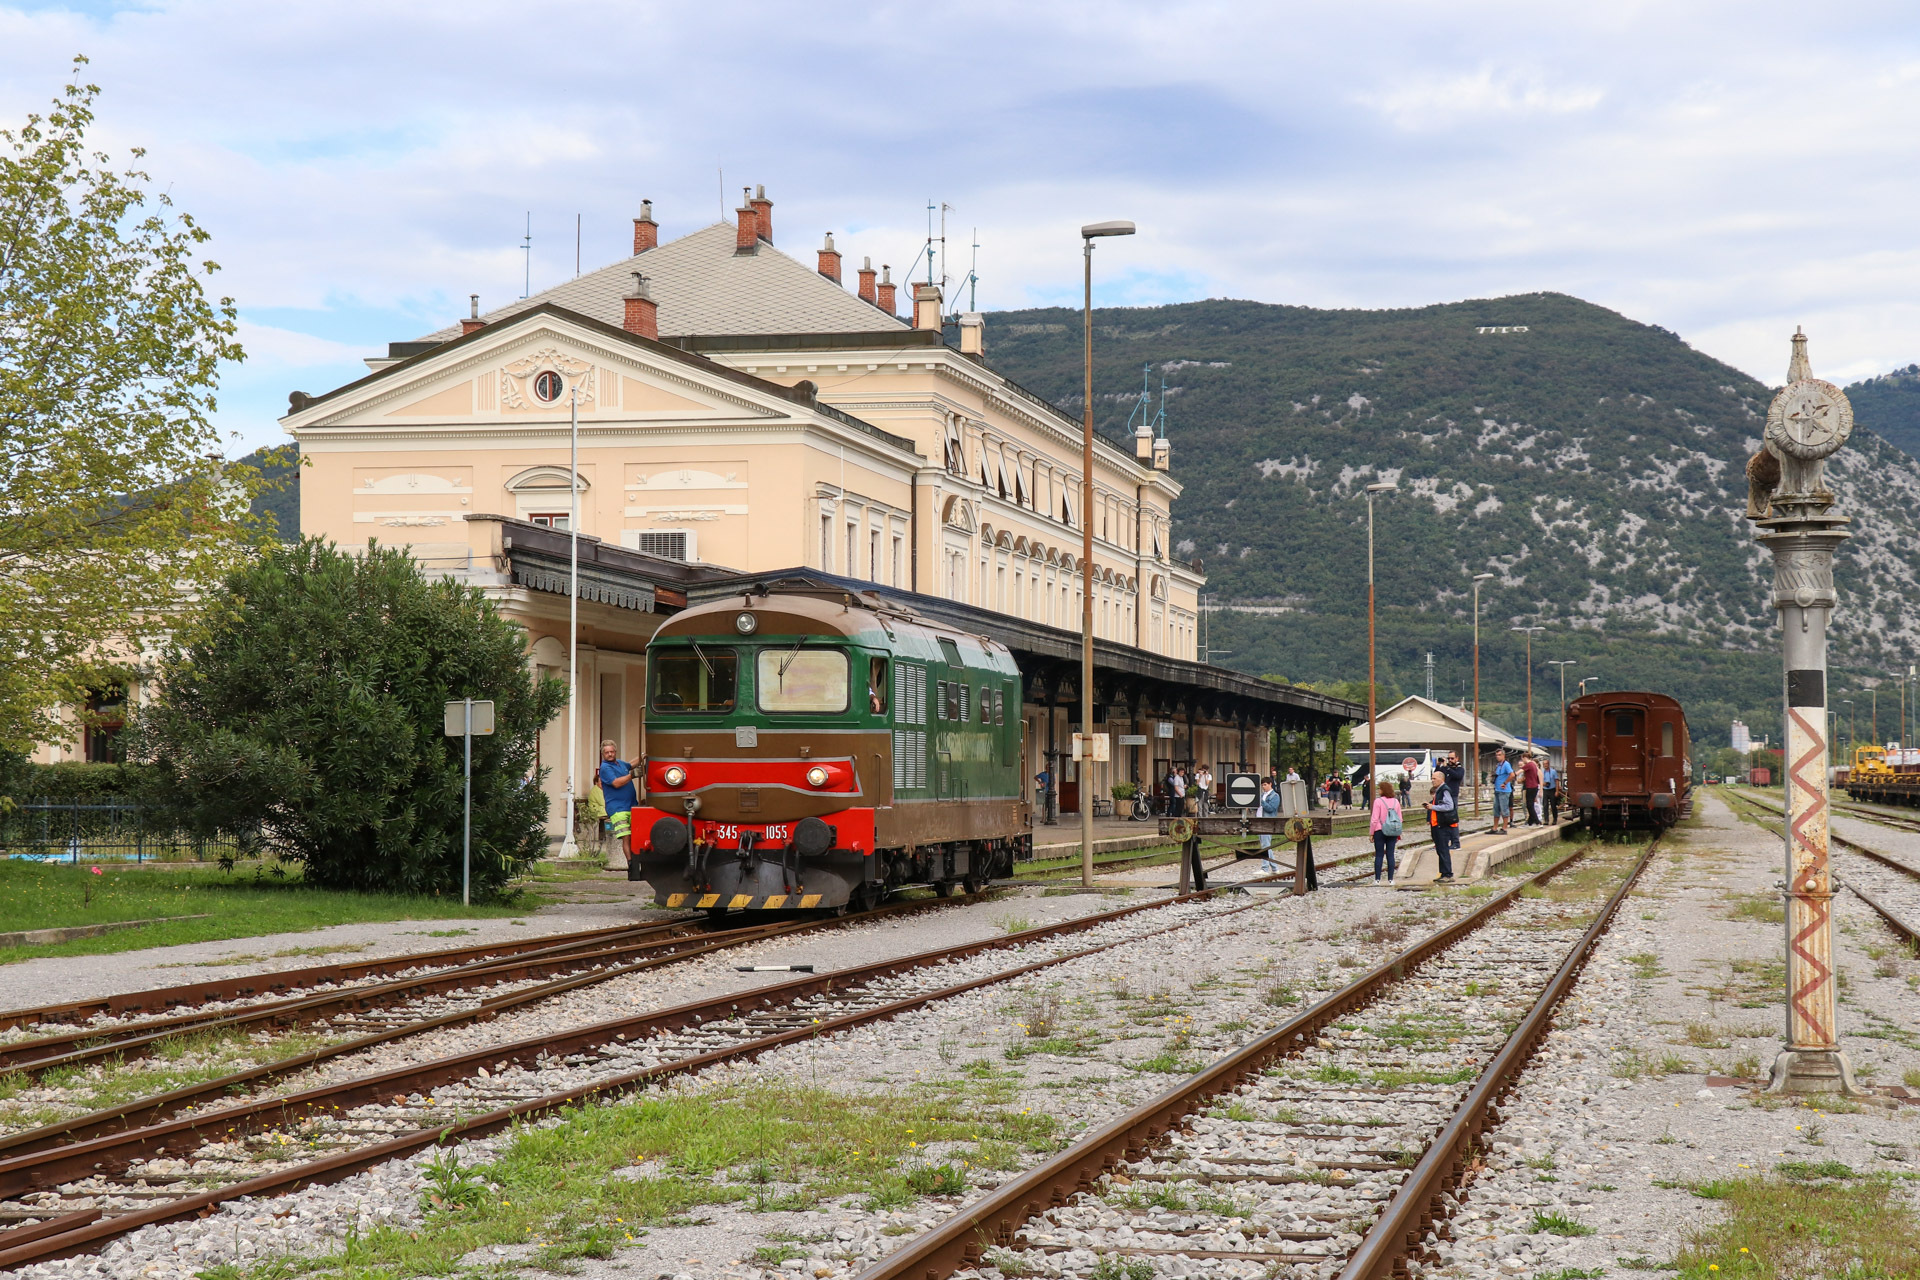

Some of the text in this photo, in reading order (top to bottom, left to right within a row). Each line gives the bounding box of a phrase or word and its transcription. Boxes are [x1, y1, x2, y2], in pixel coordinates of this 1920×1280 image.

[1475, 326, 1530, 334] TITO
[738, 729, 754, 745] FS
[765, 825, 788, 840] 1055
